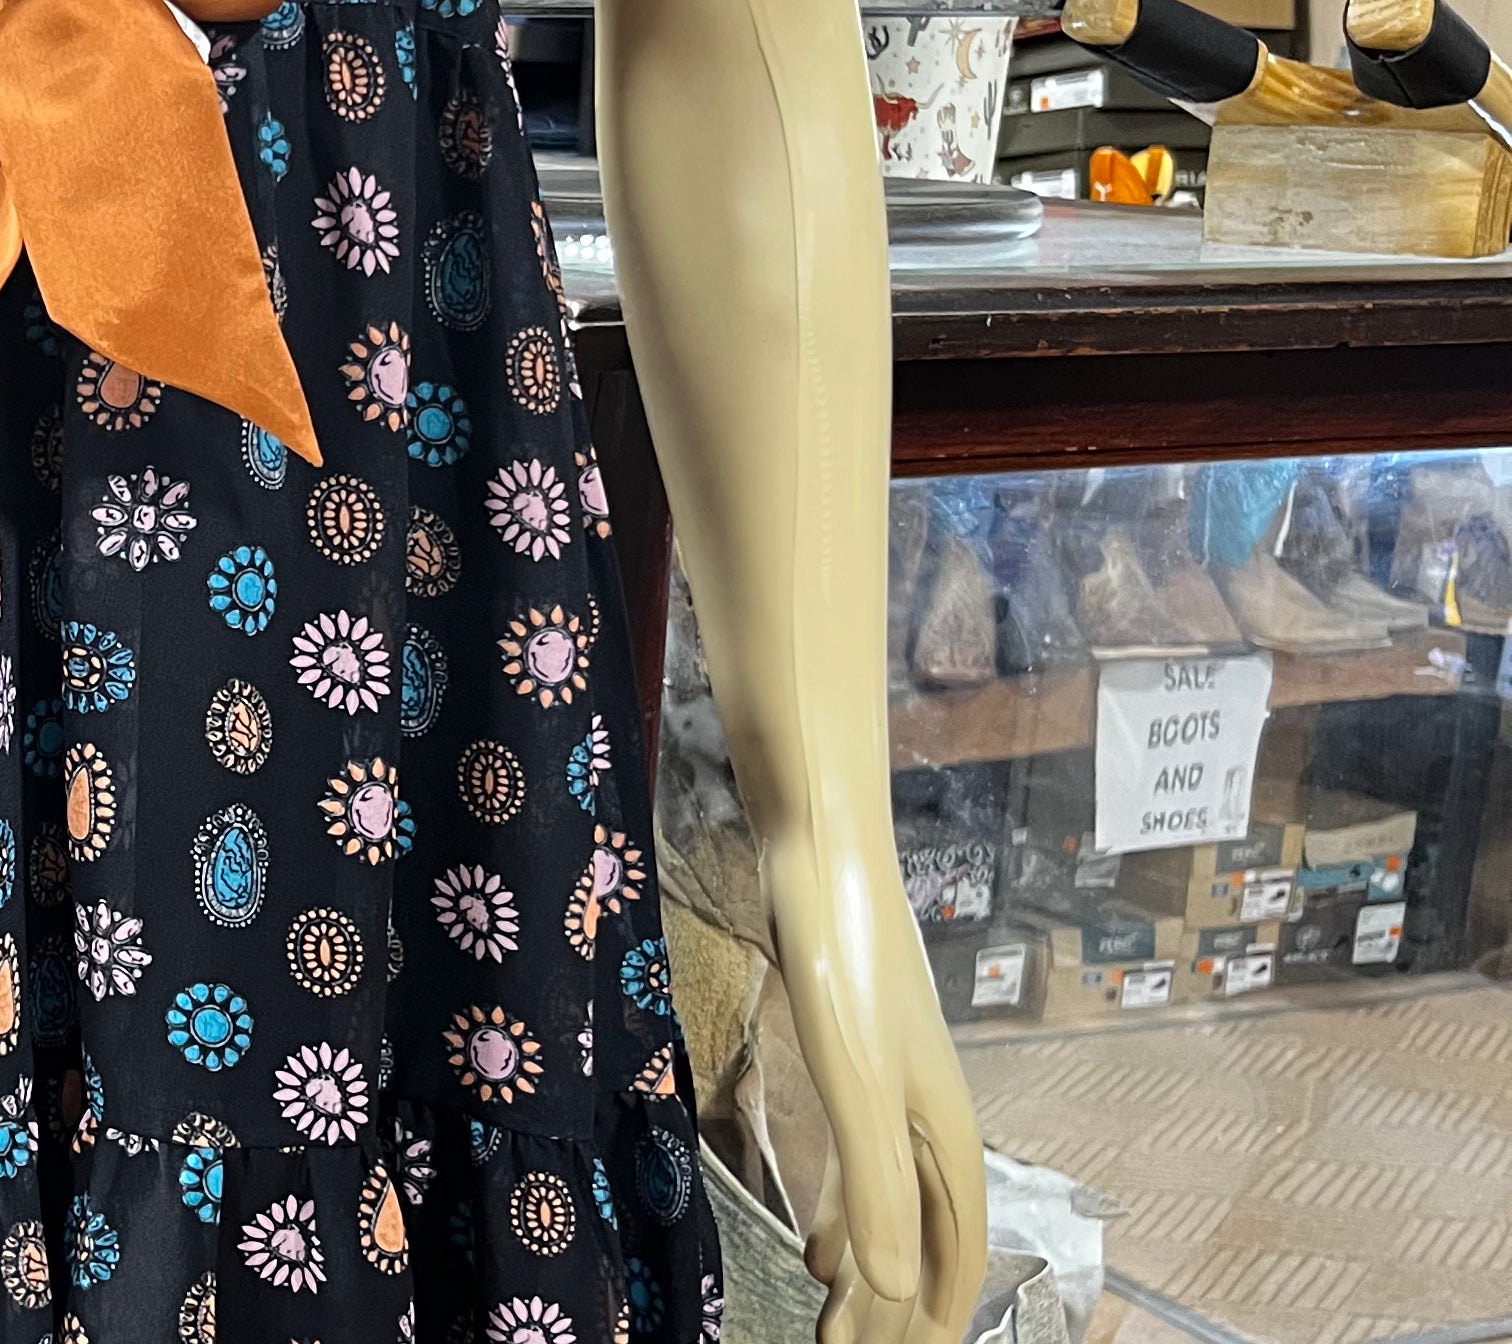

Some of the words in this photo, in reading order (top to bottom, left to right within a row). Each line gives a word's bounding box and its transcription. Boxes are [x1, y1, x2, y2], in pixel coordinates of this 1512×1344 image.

[1164, 661, 1217, 692] SALE
[1147, 709, 1221, 750] BOOTS
[1153, 762, 1204, 798] AND
[1140, 807, 1208, 835] SHOES
